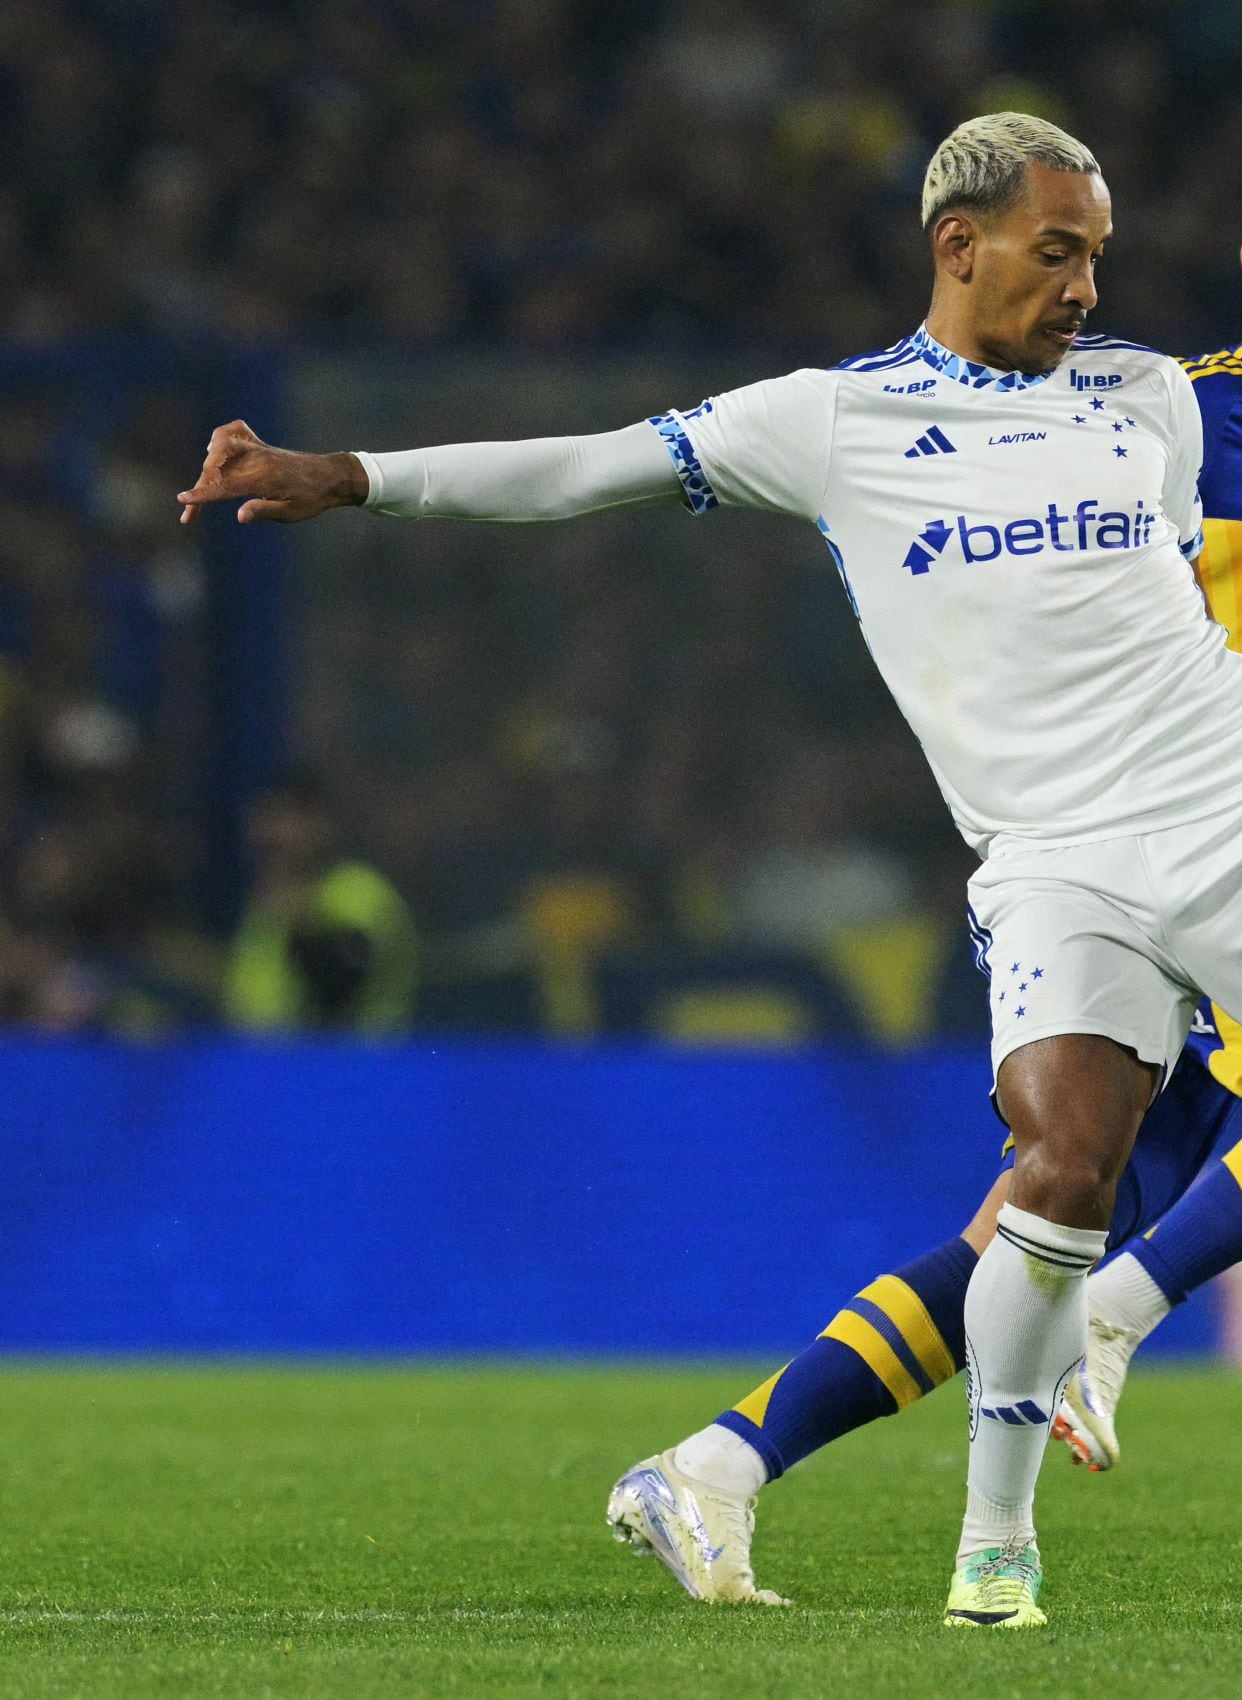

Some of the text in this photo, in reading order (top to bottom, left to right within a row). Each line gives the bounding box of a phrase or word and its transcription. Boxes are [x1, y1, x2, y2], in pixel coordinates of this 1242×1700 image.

[907, 379, 937, 394] BP
[1093, 374, 1122, 387] BP
[988, 432, 1047, 446] LAVITAN
[956, 500, 1156, 564] betfair
